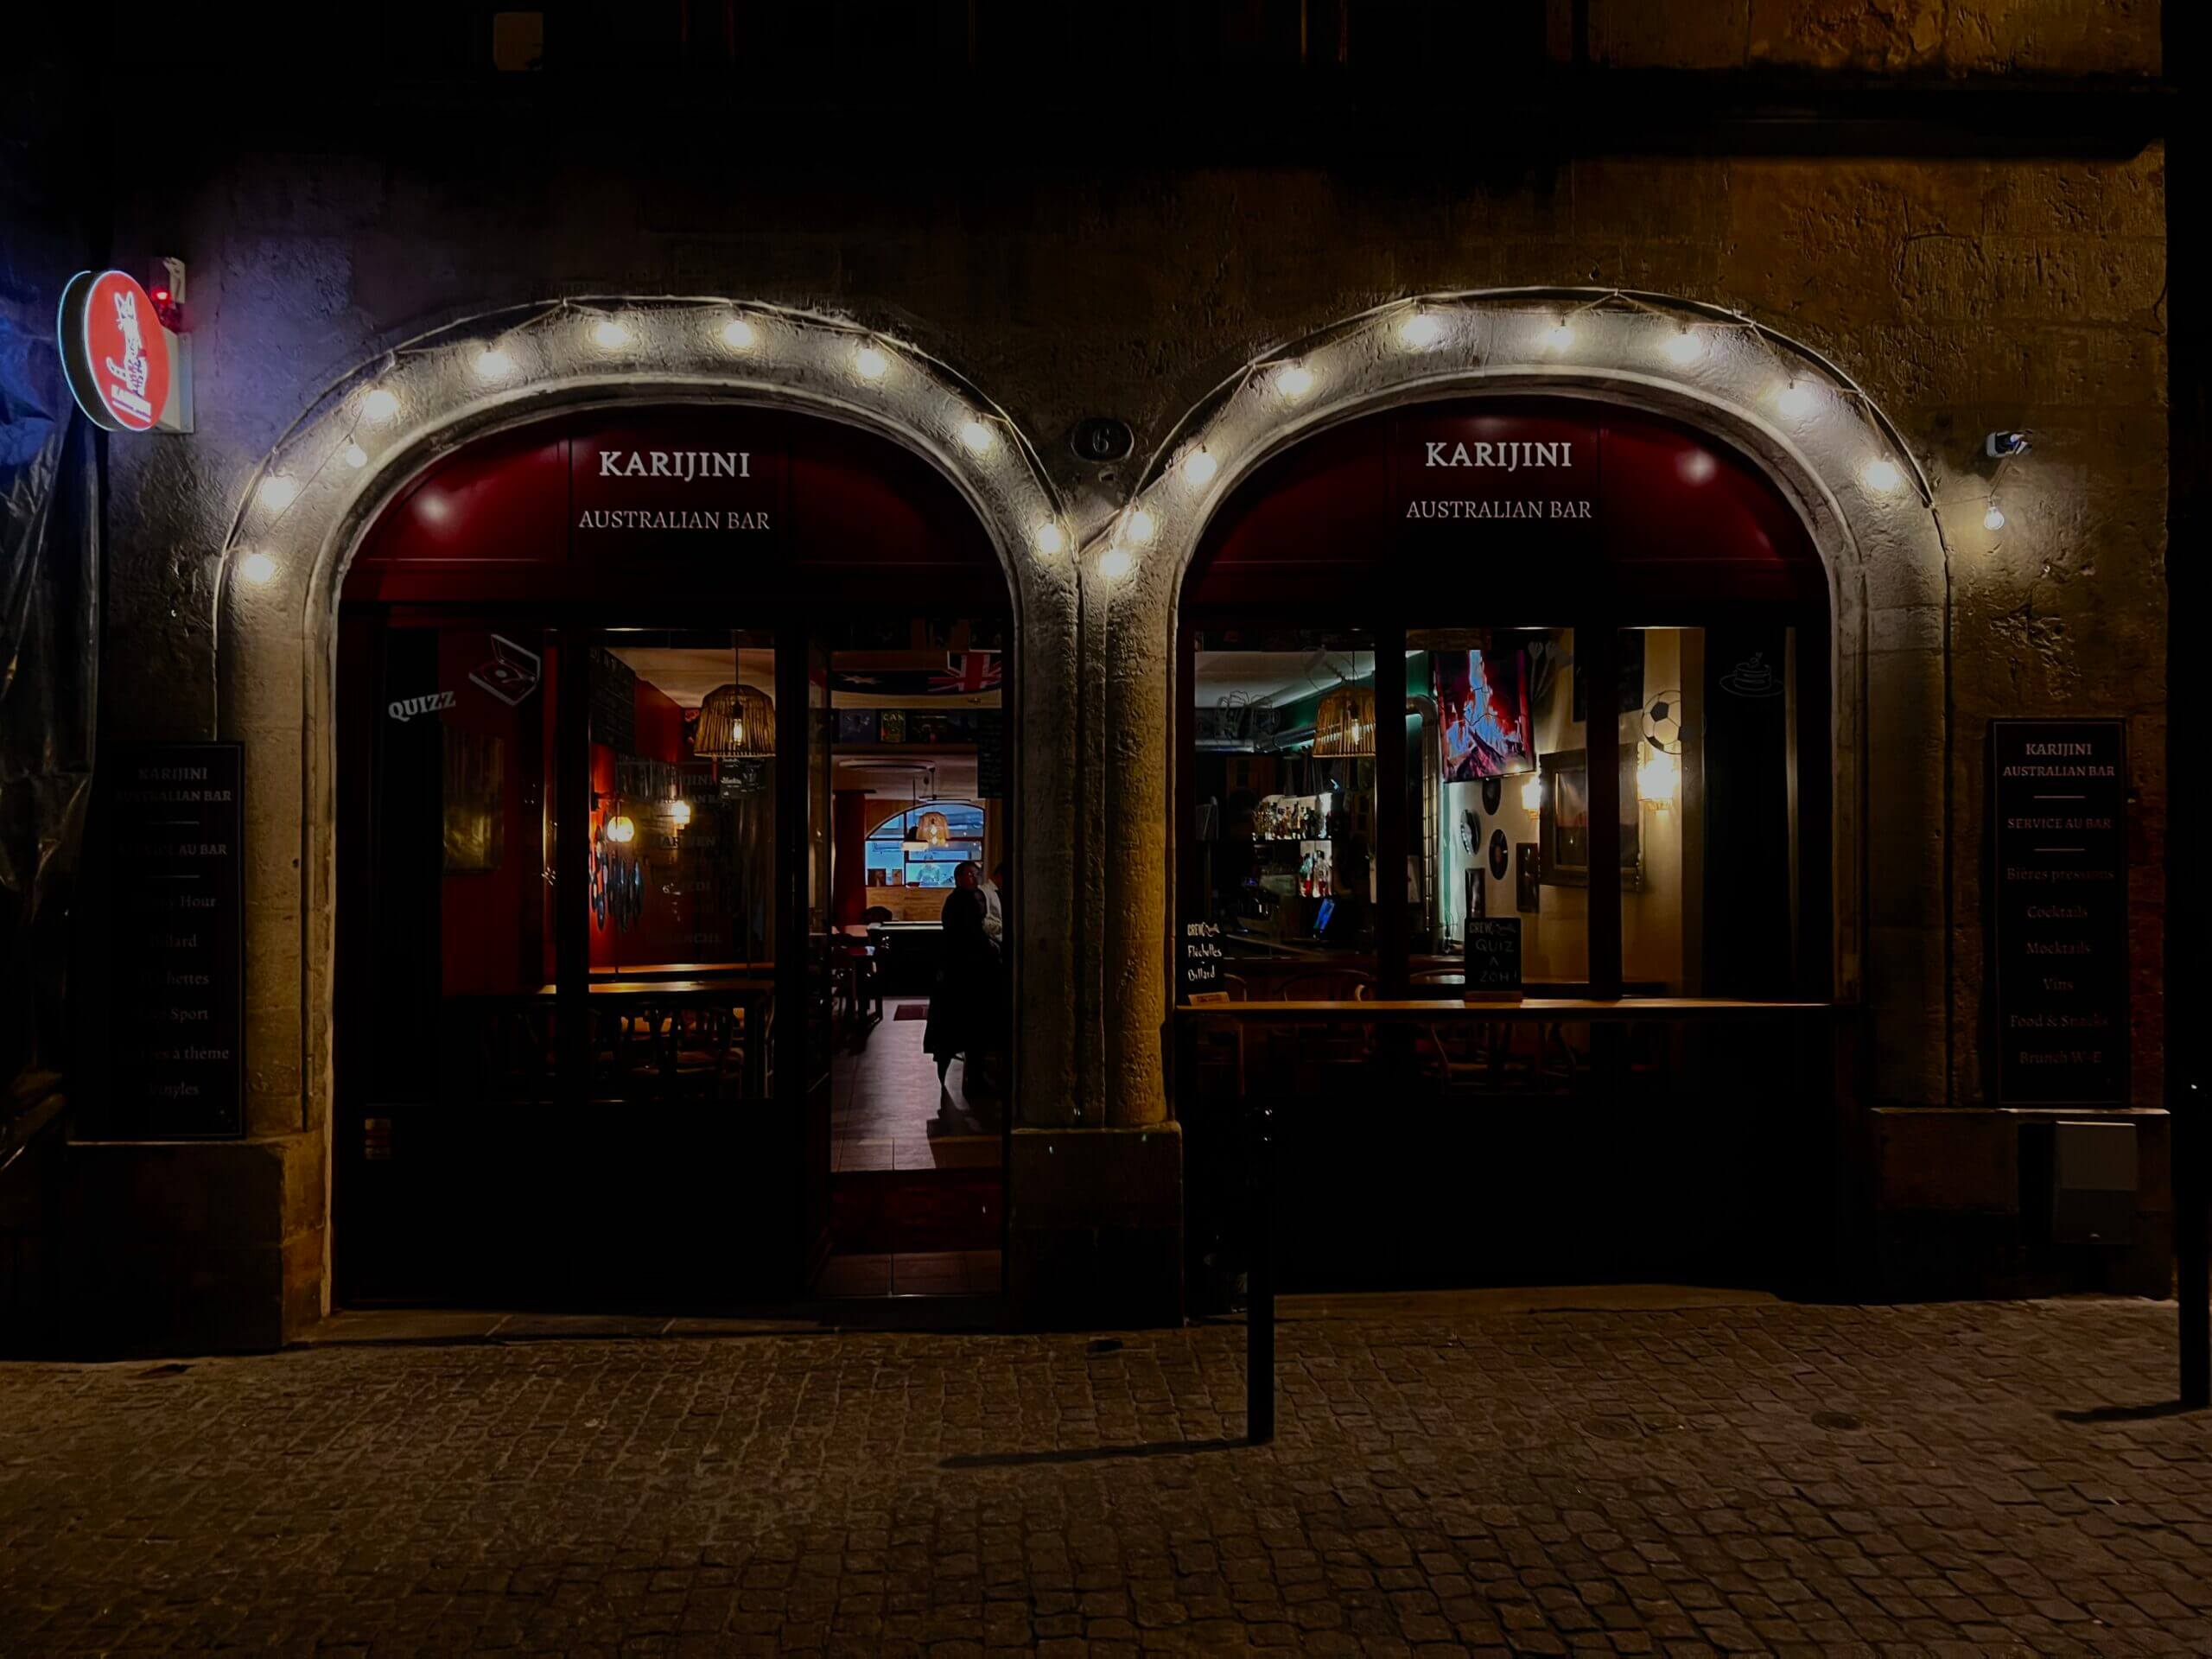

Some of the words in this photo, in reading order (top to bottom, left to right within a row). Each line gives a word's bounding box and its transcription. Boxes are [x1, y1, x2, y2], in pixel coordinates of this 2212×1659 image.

[1092, 428, 1110, 454] 6
[1425, 442, 1573, 473] KARIJINI
[599, 451, 751, 483] KARIJINI
[1406, 500, 1542, 519] AUSTRALIAN
[1549, 500, 1592, 519] BAR
[578, 510, 721, 530] AUSTRALIAN
[727, 511, 771, 531] BAR
[388, 690, 457, 722] QUIZZ
[2025, 742, 2093, 757] KARIJINI
[2003, 766, 2086, 778] AUSTRALIAN
[2088, 766, 2116, 778] BAR
[203, 790, 232, 803] BAR
[2006, 817, 2063, 830] SERVICE
[2064, 817, 2083, 830] AU
[2085, 817, 2113, 830] BAR
[179, 843, 198, 856] AU
[199, 843, 228, 856] BAR
[179, 894, 218, 908] Hour
[2026, 905, 2089, 918] Cocktails
[1475, 938, 1516, 954] QUIZ
[2025, 940, 2093, 954] Mocktails
[1187, 963, 1216, 982] Billard
[2042, 976, 2075, 991] Vins
[170, 1007, 209, 1024] Sport
[2010, 1014, 2044, 1027] Food
[2046, 1014, 2058, 1027] &
[2019, 1050, 2068, 1065] Brunch
